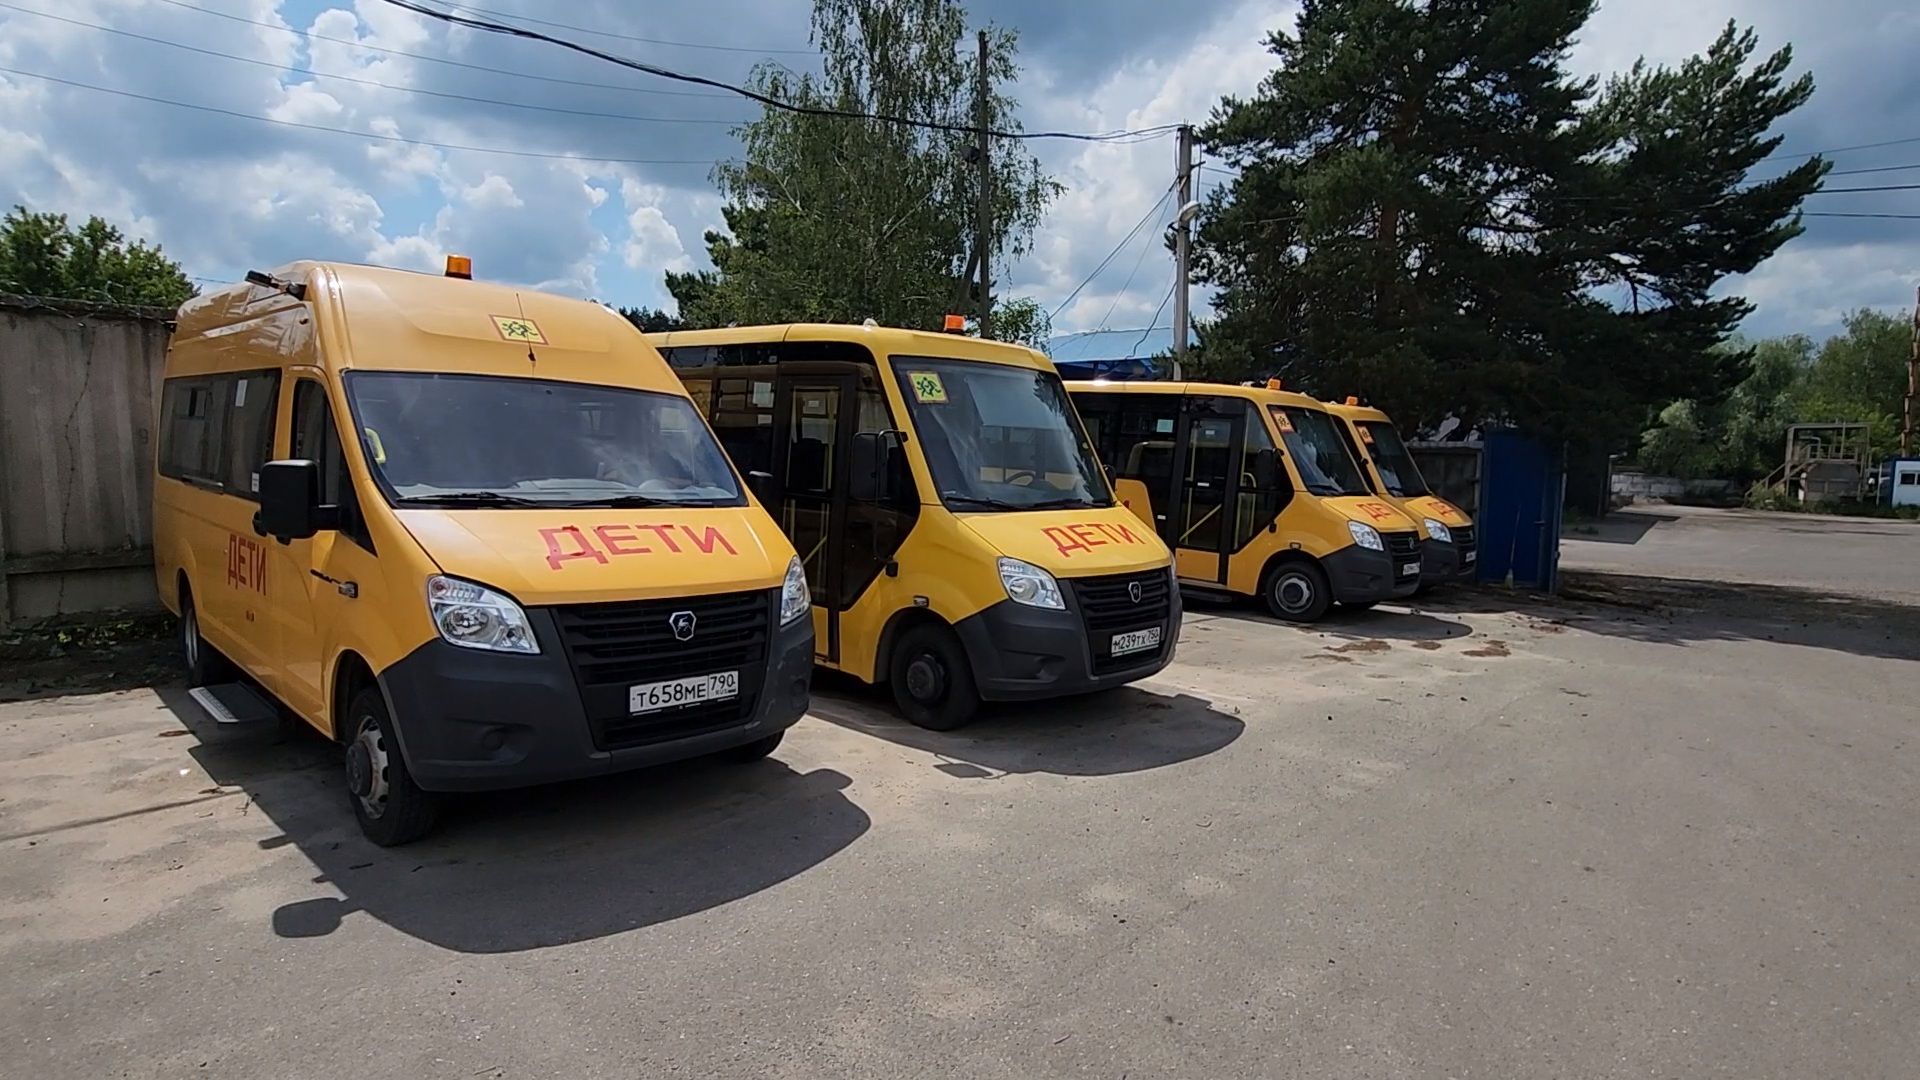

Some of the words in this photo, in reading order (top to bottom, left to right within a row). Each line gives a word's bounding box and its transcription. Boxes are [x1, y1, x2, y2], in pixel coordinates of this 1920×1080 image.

[538, 524, 738, 570] ДЕТИ
[1041, 523, 1146, 558] ДЕТИ
[228, 533, 266, 596] ДЕТИ
[637, 683, 706, 708] Т658МЕ
[710, 673, 734, 691] 790
